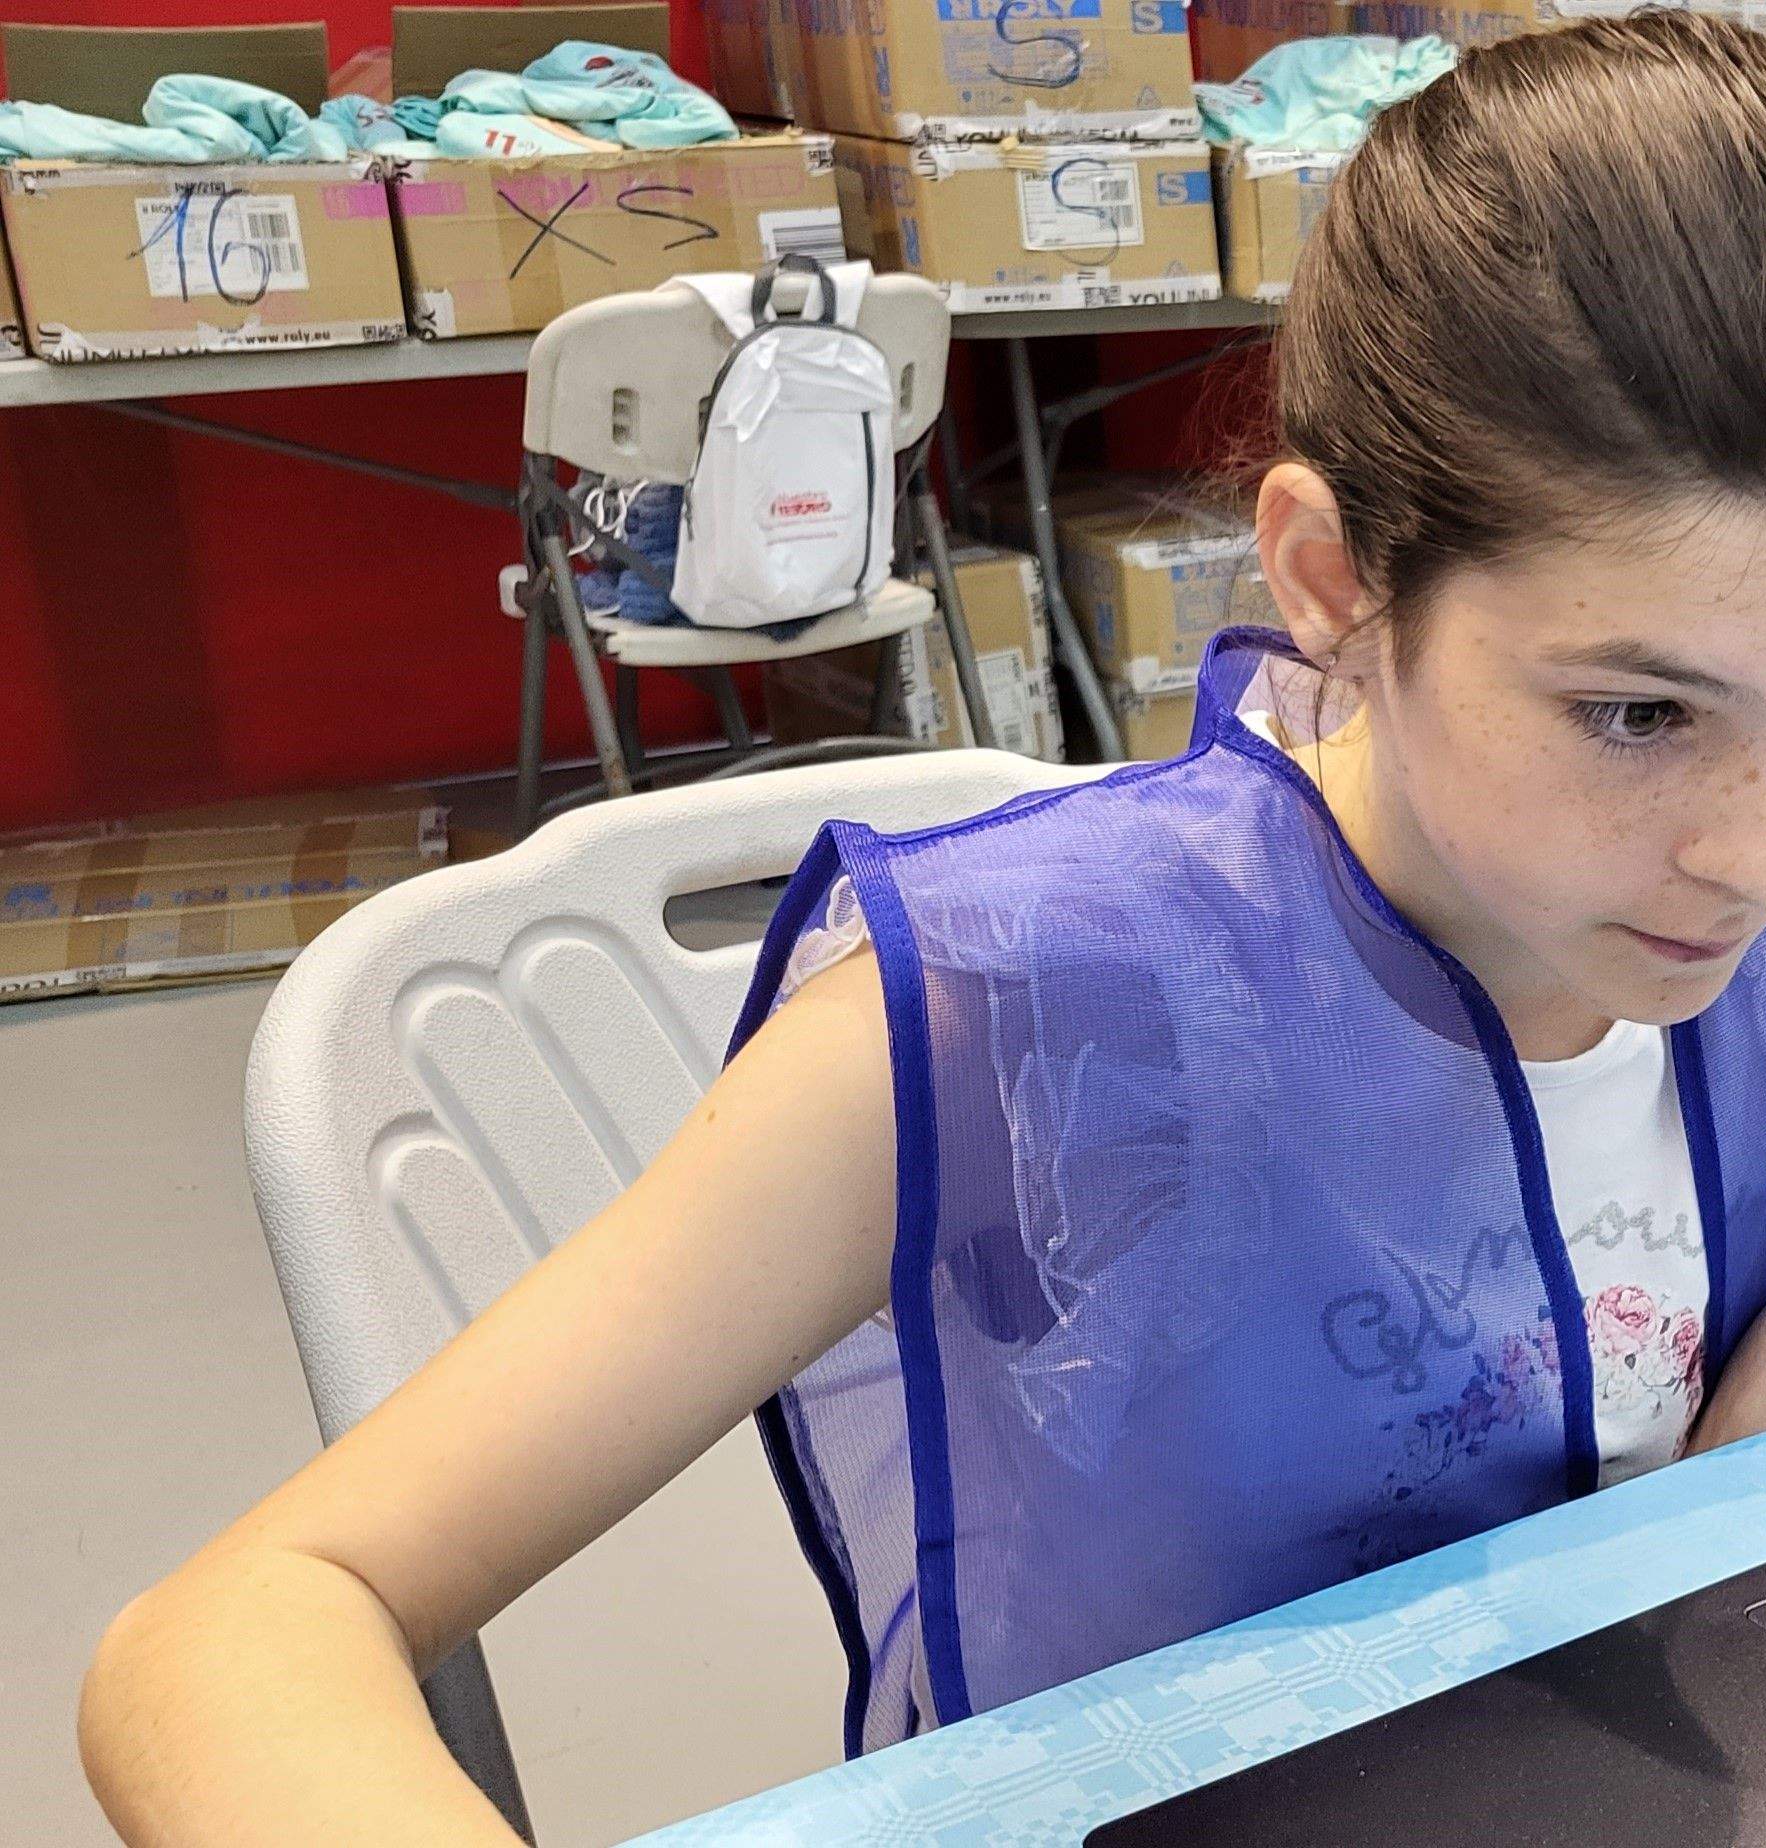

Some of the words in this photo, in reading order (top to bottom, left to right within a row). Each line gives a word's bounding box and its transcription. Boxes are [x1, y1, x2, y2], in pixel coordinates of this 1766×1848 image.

[497, 182, 719, 280] XS
[1158, 174, 1189, 203] S
[126, 183, 272, 306] 16
